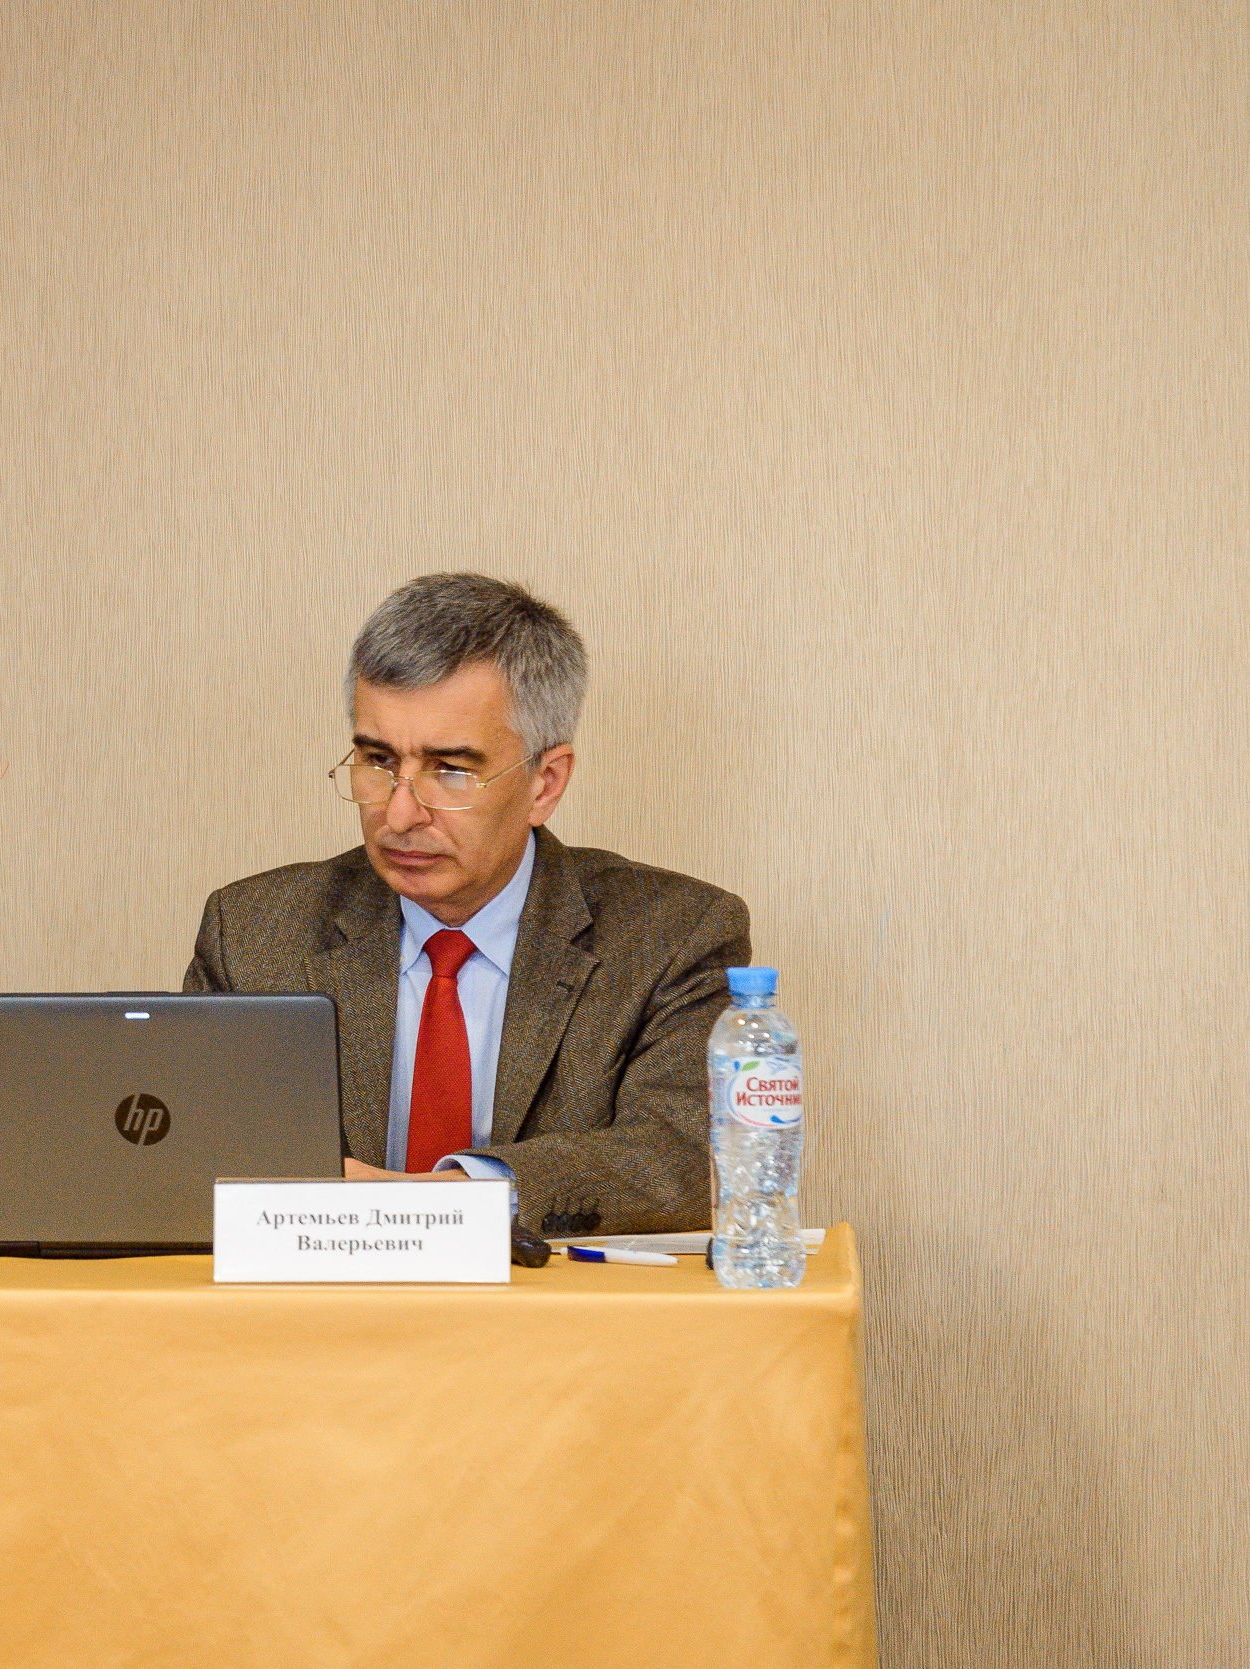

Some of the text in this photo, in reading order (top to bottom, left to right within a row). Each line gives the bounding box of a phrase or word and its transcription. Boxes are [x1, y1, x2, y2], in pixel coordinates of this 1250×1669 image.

[122, 1093, 165, 1146] hp
[256, 1209, 464, 1230] Артемьев Дмитрий
[297, 1234, 424, 1256] Валерьевич
